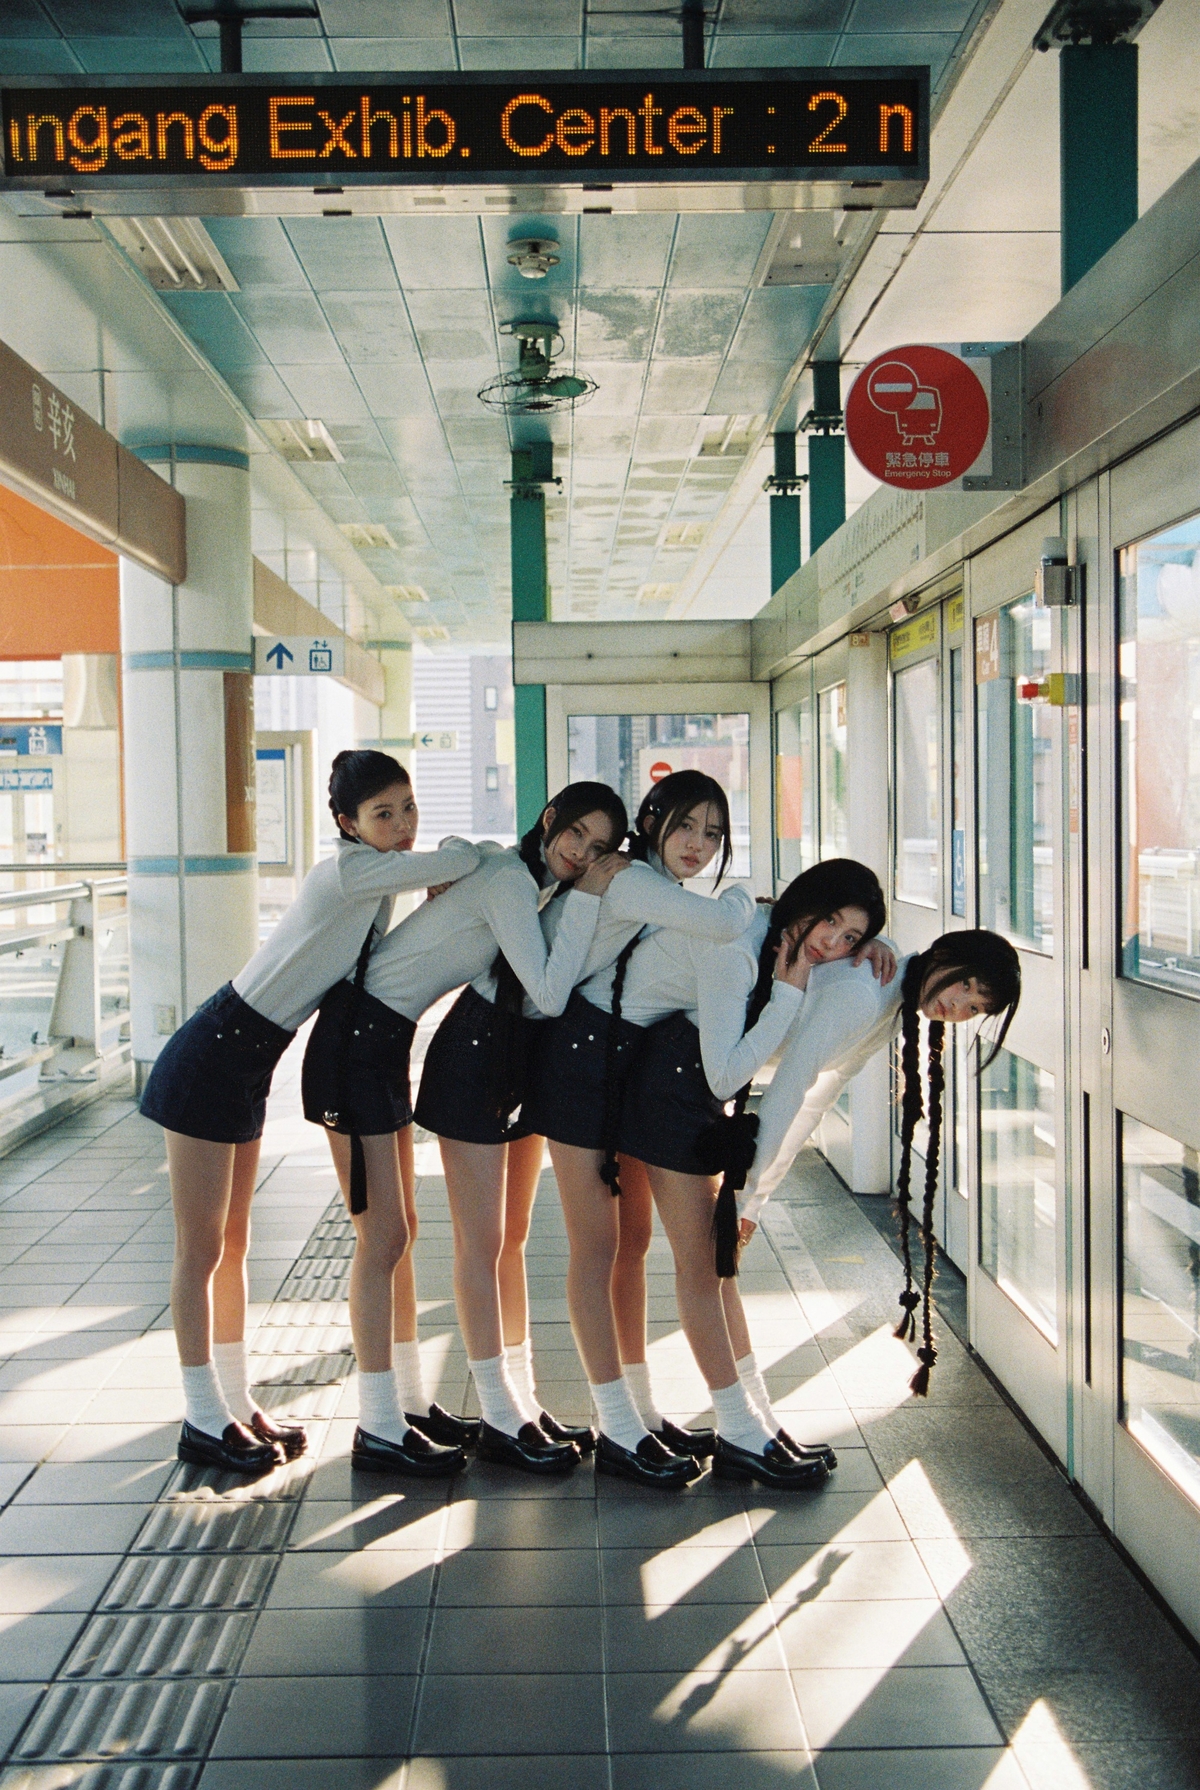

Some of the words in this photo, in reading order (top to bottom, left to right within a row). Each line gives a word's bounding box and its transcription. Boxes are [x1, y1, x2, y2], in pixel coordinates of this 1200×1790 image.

[269, 95, 470, 159] Exhib.
[501, 93, 734, 157] Center
[767, 107, 775, 153] :
[808, 91, 848, 153] 2
[885, 451, 950, 468] 緊急停車
[884, 469, 931, 479] Emergency
[932, 469, 952, 478] Stop
